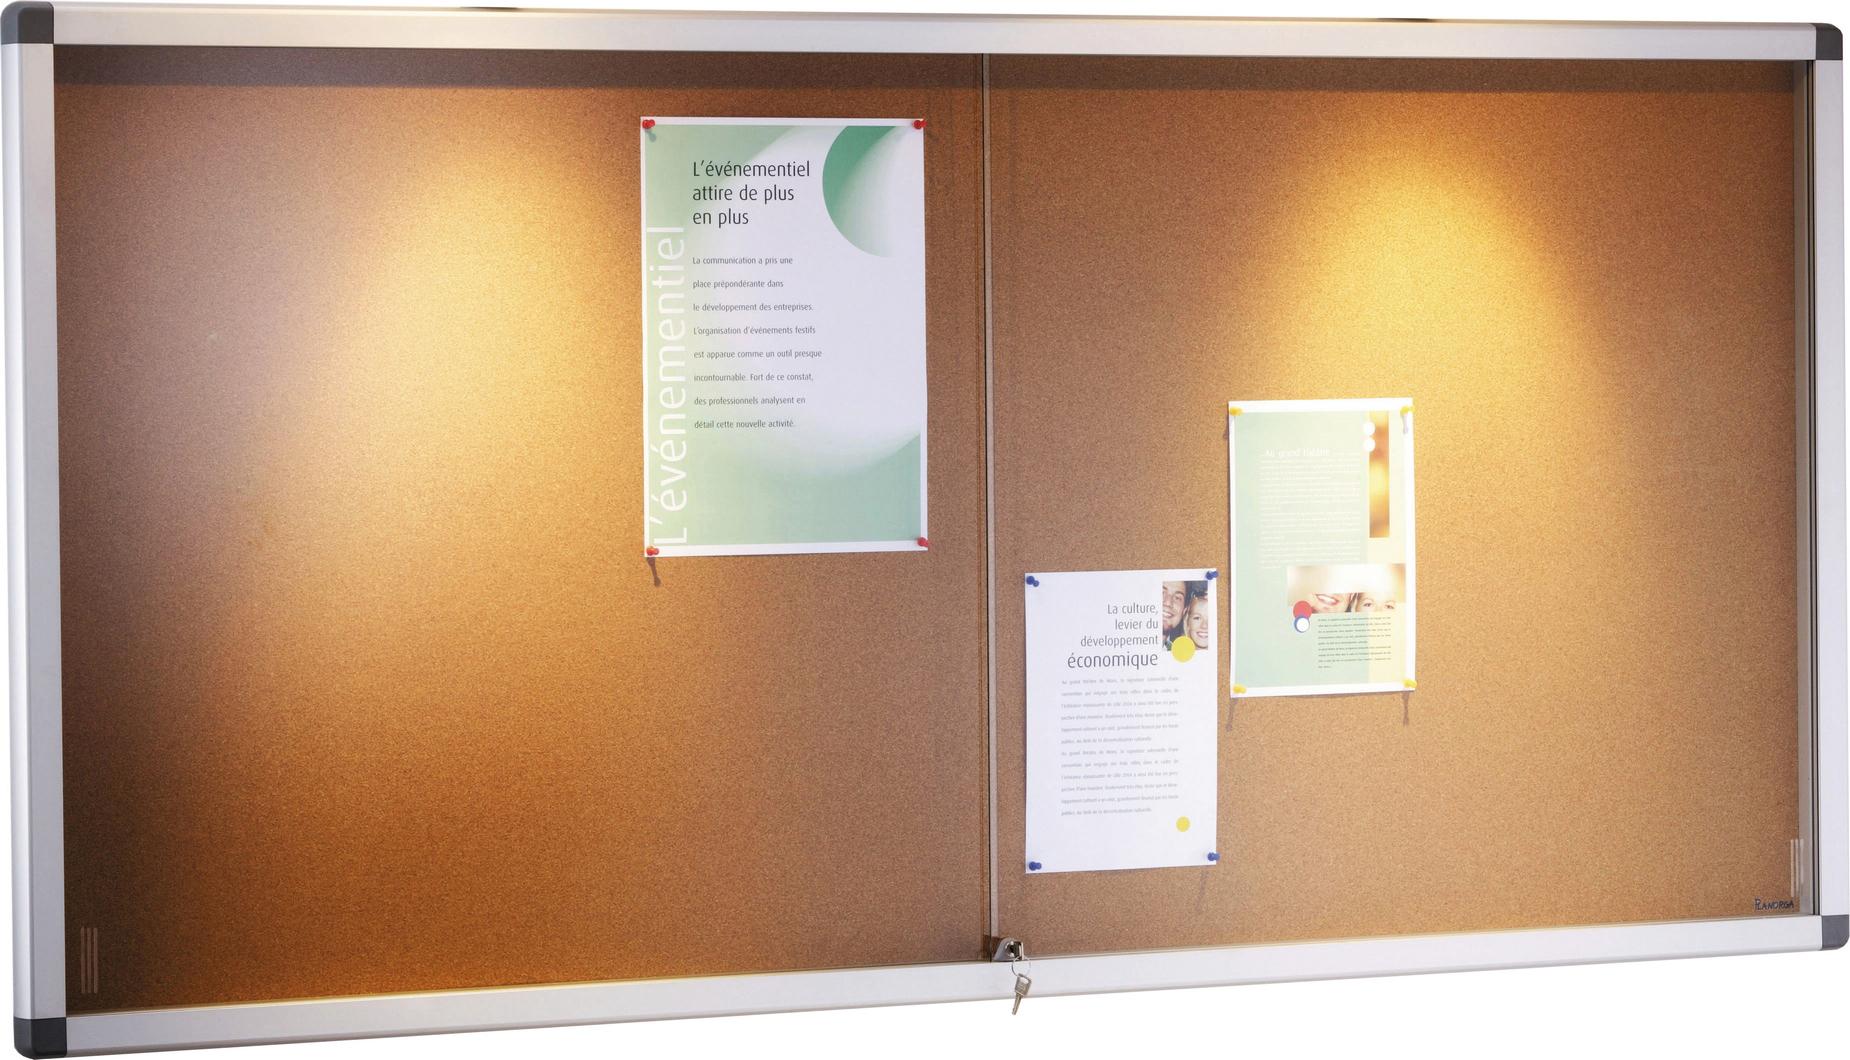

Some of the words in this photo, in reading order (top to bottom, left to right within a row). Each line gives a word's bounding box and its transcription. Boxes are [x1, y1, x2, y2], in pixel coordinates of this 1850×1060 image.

[693, 185, 732, 200] attire
[740, 184, 757, 200] de
[765, 184, 794, 205] plus
[693, 213, 711, 224] en
[719, 208, 748, 228] plus
[693, 280, 711, 289] place
[714, 280, 765, 288] prépondérante
[694, 350, 704, 358] est
[707, 352, 735, 360] apparue
[777, 349, 792, 357] outil
[795, 351, 822, 359] presque
[694, 397, 706, 405] des
[709, 396, 758, 406] professionnels
[761, 396, 794, 405] analysent
[1108, 604, 1118, 614] La
[1122, 602, 1159, 616] culture,
[1115, 619, 1142, 630] levier
[1146, 618, 1158, 629] du
[1081, 635, 1158, 648] développement
[1068, 651, 1158, 670] économique
